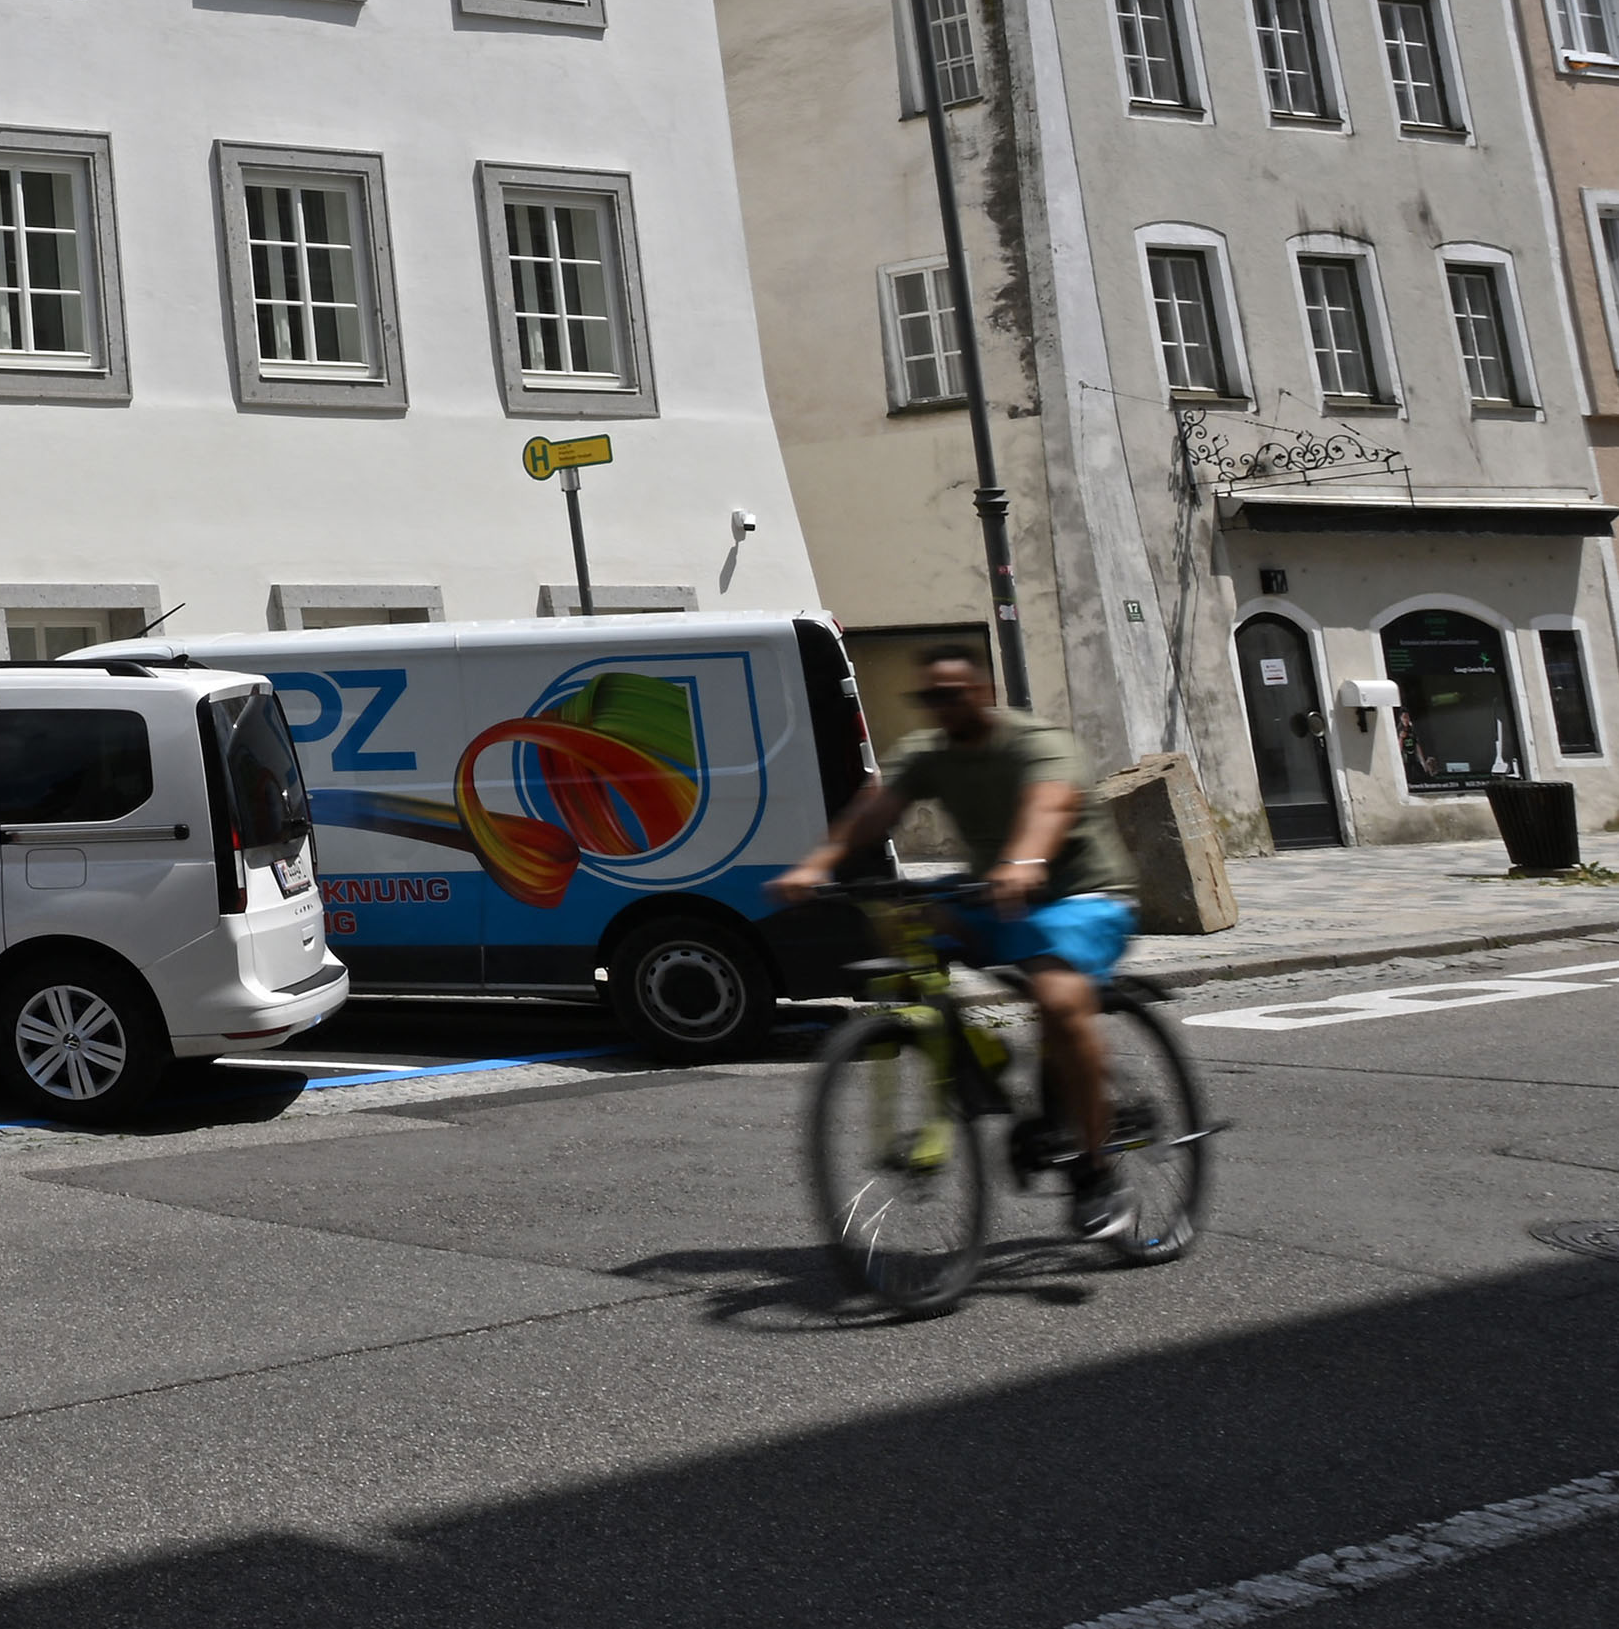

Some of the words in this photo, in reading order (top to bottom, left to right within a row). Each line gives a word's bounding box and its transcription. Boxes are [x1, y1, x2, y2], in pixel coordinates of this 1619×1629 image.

[530, 444, 549, 472] H
[1127, 602, 1138, 613] 17
[320, 877, 451, 903] KNUNG
